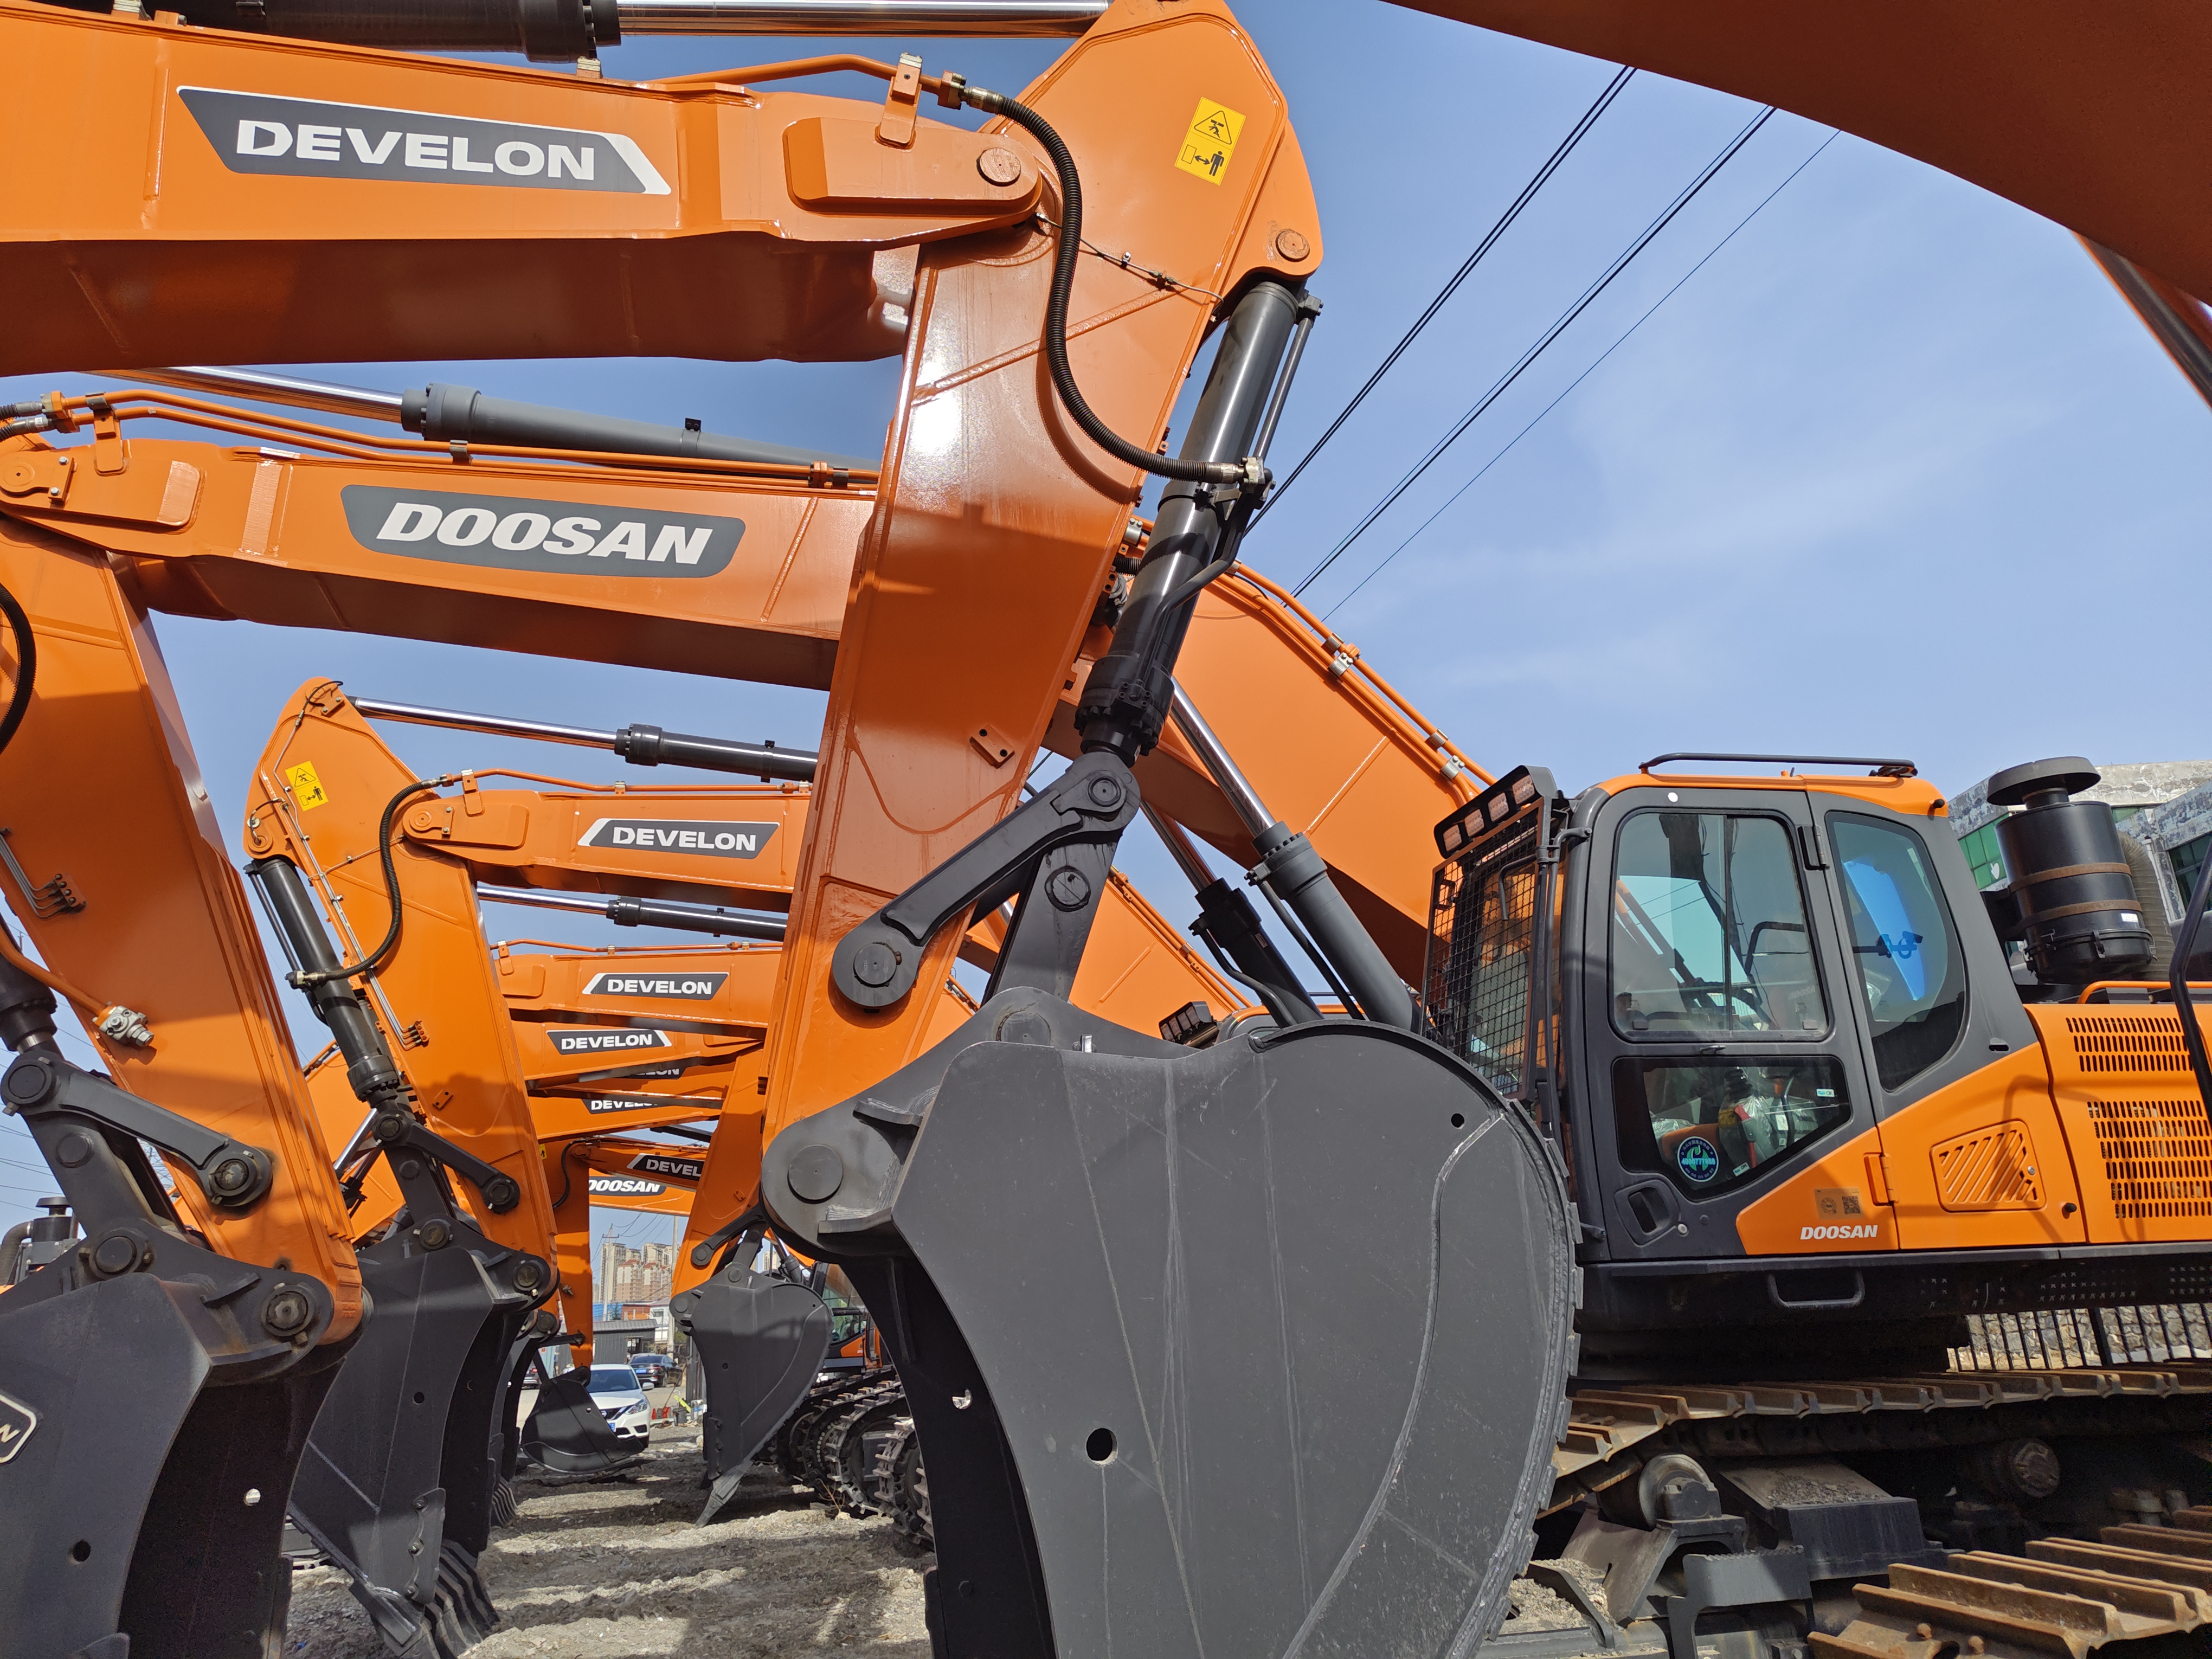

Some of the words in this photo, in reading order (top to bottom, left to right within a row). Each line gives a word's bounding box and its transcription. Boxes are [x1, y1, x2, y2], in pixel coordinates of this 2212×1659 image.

[236, 119, 594, 181] DEVELON
[376, 502, 713, 564] DOOSAN
[613, 826, 756, 851] DEVELON
[607, 979, 712, 994] DEVELON
[561, 1034, 652, 1050] DEVELON
[646, 1159, 702, 1178] DEVEL
[1800, 1225, 1878, 1240] DOOSAN
